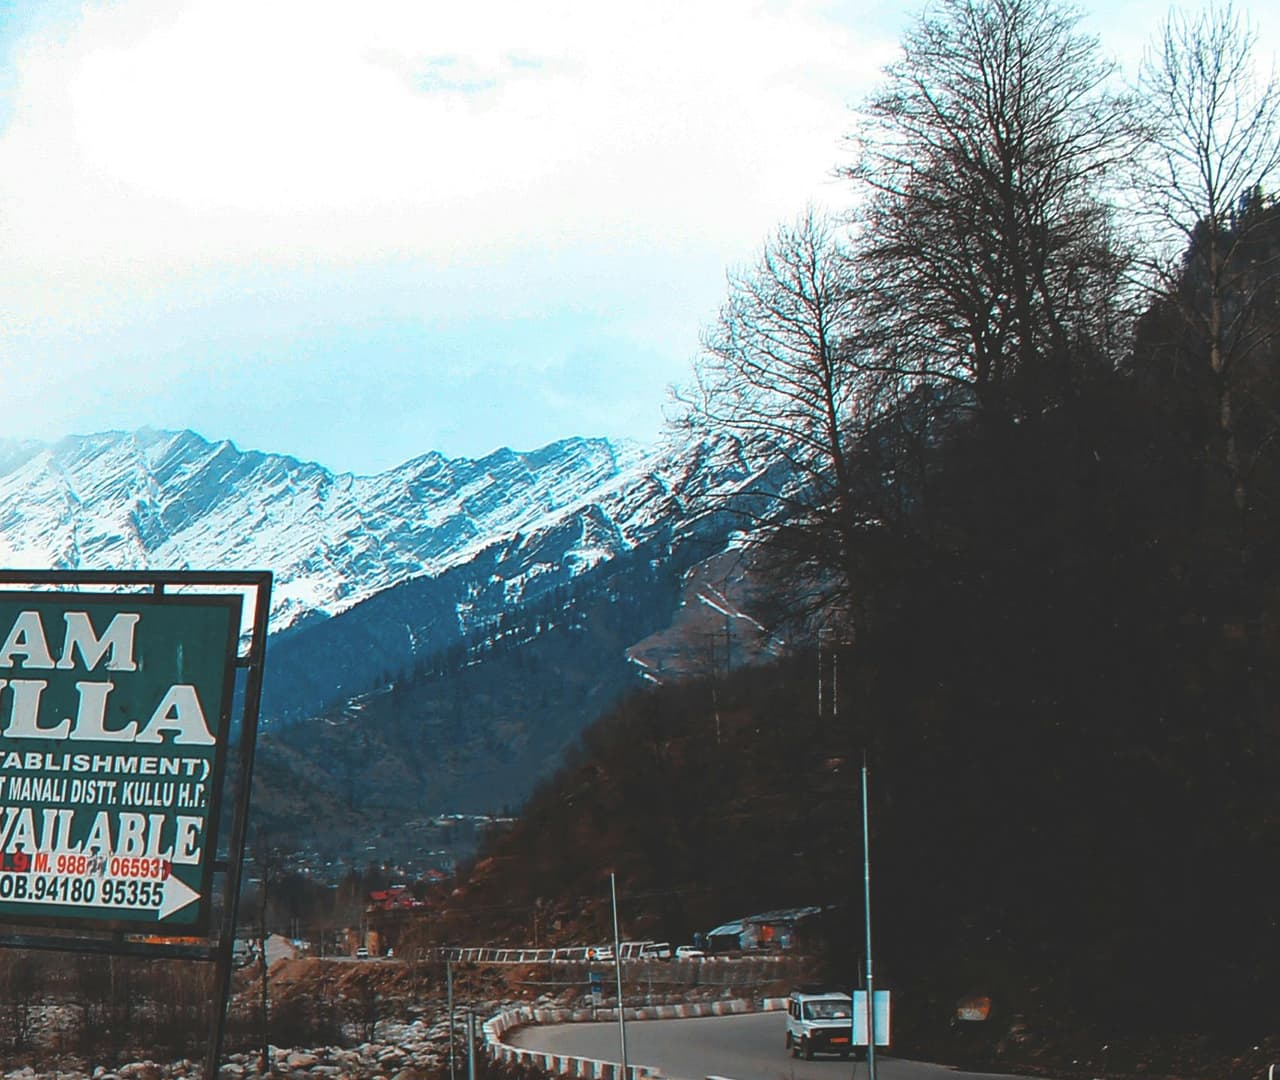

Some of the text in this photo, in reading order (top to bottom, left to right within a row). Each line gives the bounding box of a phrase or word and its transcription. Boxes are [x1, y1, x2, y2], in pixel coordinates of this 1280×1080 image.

[8, 776, 68, 802] MANALI
[70, 779, 117, 805] DISTT.
[121, 781, 174, 808] KULLU
[101, 879, 165, 906] 95355
